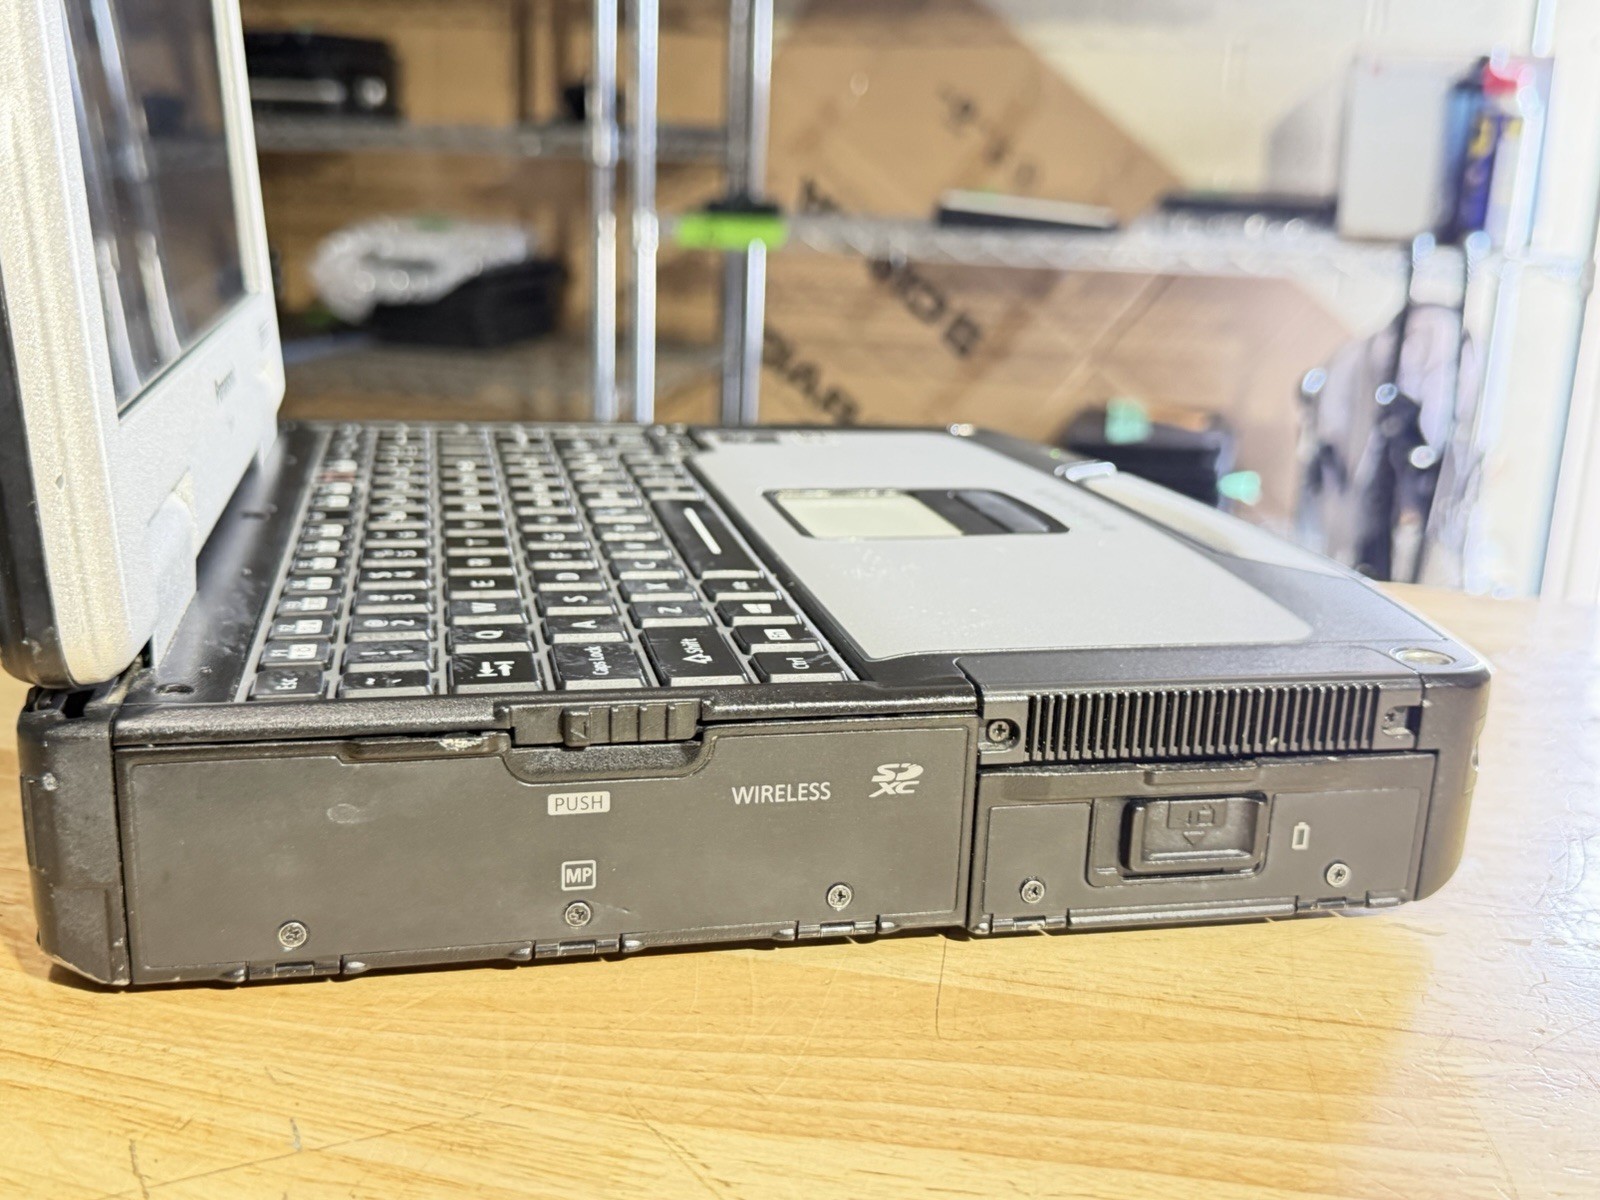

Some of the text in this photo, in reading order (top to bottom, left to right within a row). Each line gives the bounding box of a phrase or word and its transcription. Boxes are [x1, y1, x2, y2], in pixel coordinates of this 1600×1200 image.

[633, 561, 657, 570] C
[555, 572, 580, 581] D
[470, 579, 496, 588] E
[562, 595, 588, 604] S
[471, 602, 497, 613] W
[657, 606, 683, 615] Z
[390, 619, 415, 627] 2
[571, 619, 596, 630] A
[474, 630, 503, 640] Q
[680, 637, 704, 654] Shift
[269, 649, 289, 657] F1
[584, 645, 612, 676] Caps Lock
[786, 657, 810, 670] Ctrl
[275, 677, 299, 690] Esc
[731, 781, 832, 805] WIRELESS
[868, 780, 920, 798] XC
[554, 794, 604, 812] PUSH
[566, 867, 593, 884] MP
